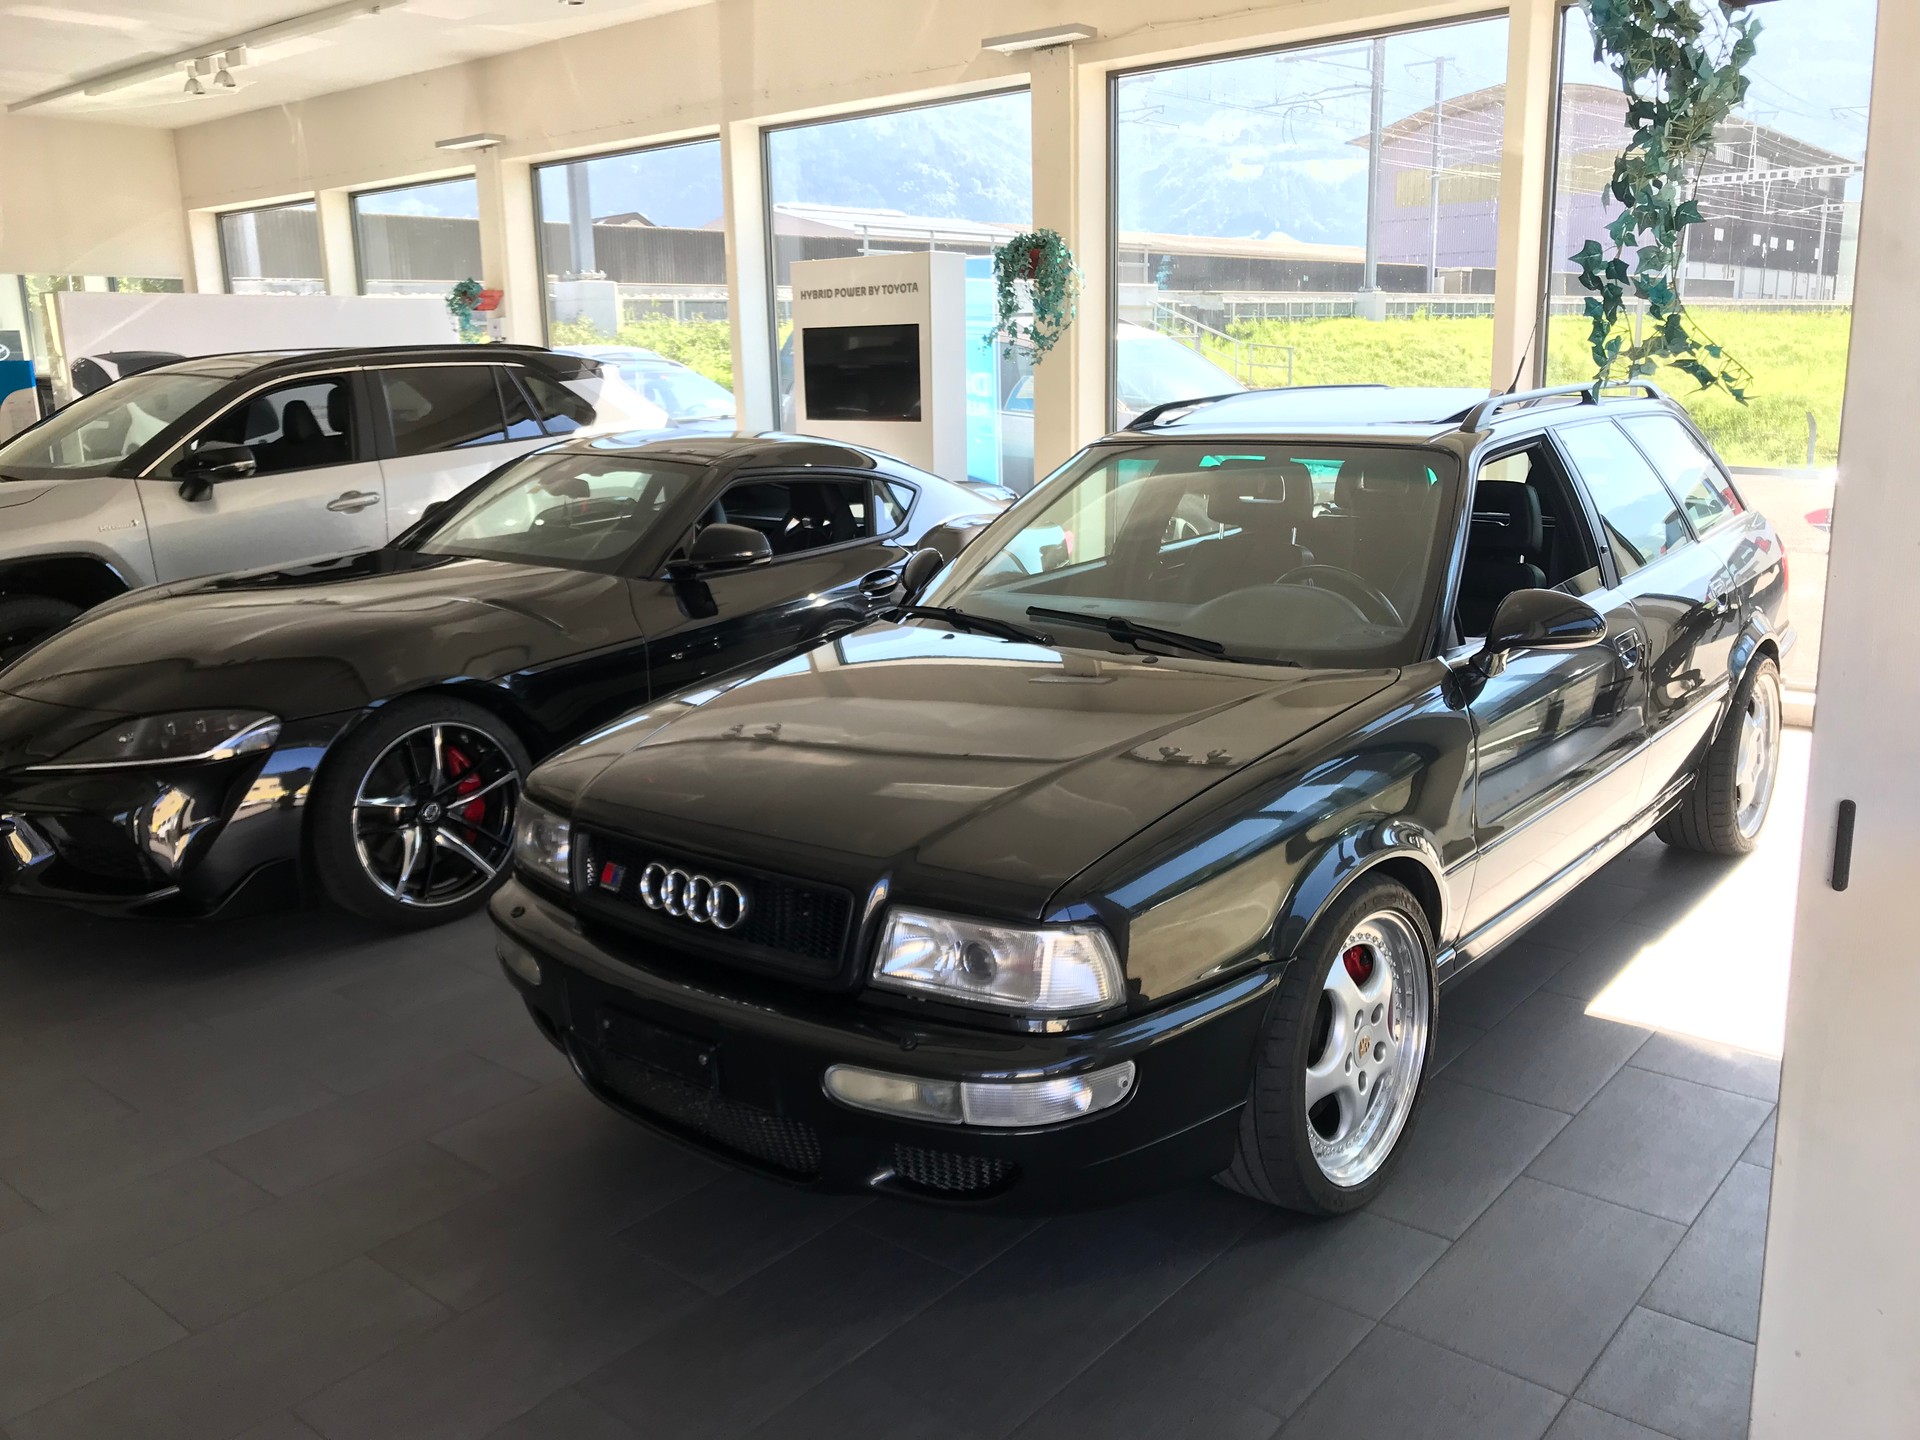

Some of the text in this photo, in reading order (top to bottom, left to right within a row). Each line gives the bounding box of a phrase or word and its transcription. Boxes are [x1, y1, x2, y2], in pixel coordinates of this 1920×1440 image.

[800, 282, 919, 300] HYBRID POWER BY TOYOTA
